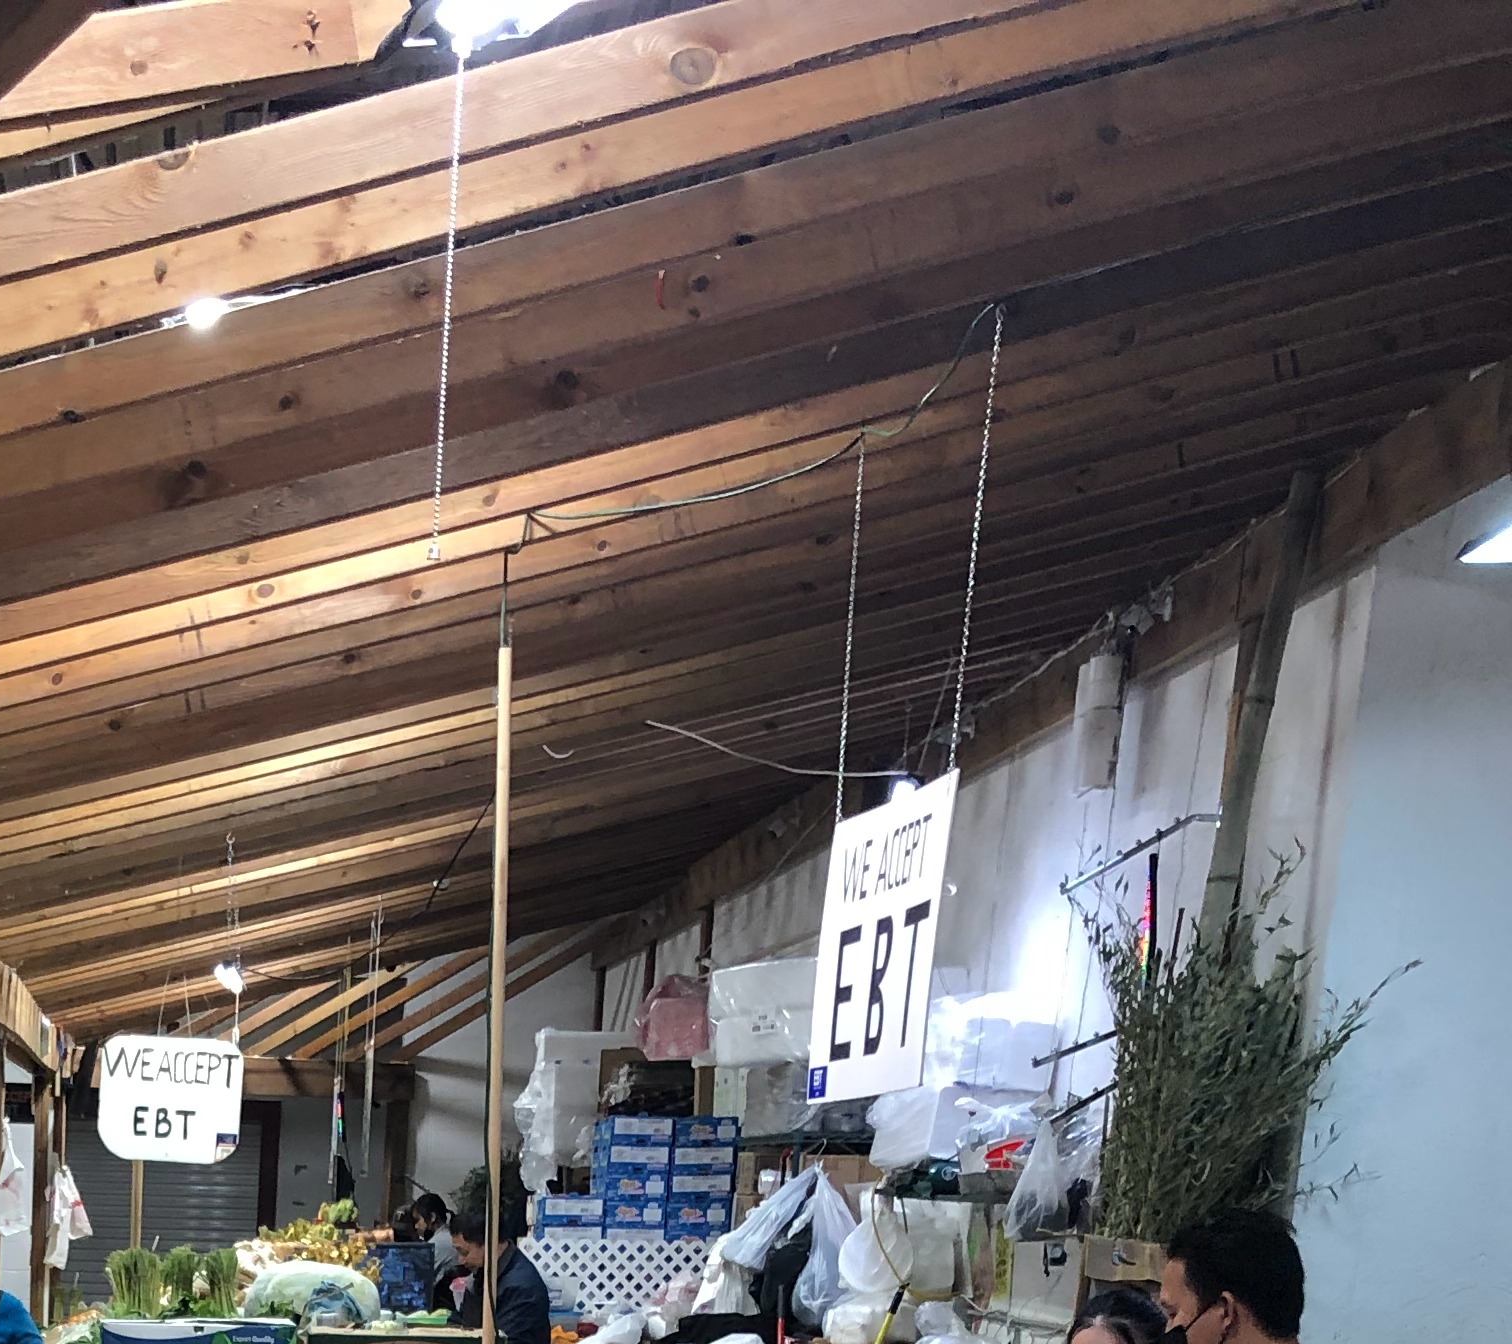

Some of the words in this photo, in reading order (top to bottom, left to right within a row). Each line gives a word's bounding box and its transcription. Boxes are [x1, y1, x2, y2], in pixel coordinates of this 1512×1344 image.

[843, 838, 874, 904] WE
[873, 812, 933, 896] ACCEPT
[829, 898, 932, 1063] EBT
[104, 1044, 155, 1082] WE
[155, 1050, 240, 1089] ACCEPT
[133, 1105, 197, 1141] EBT
